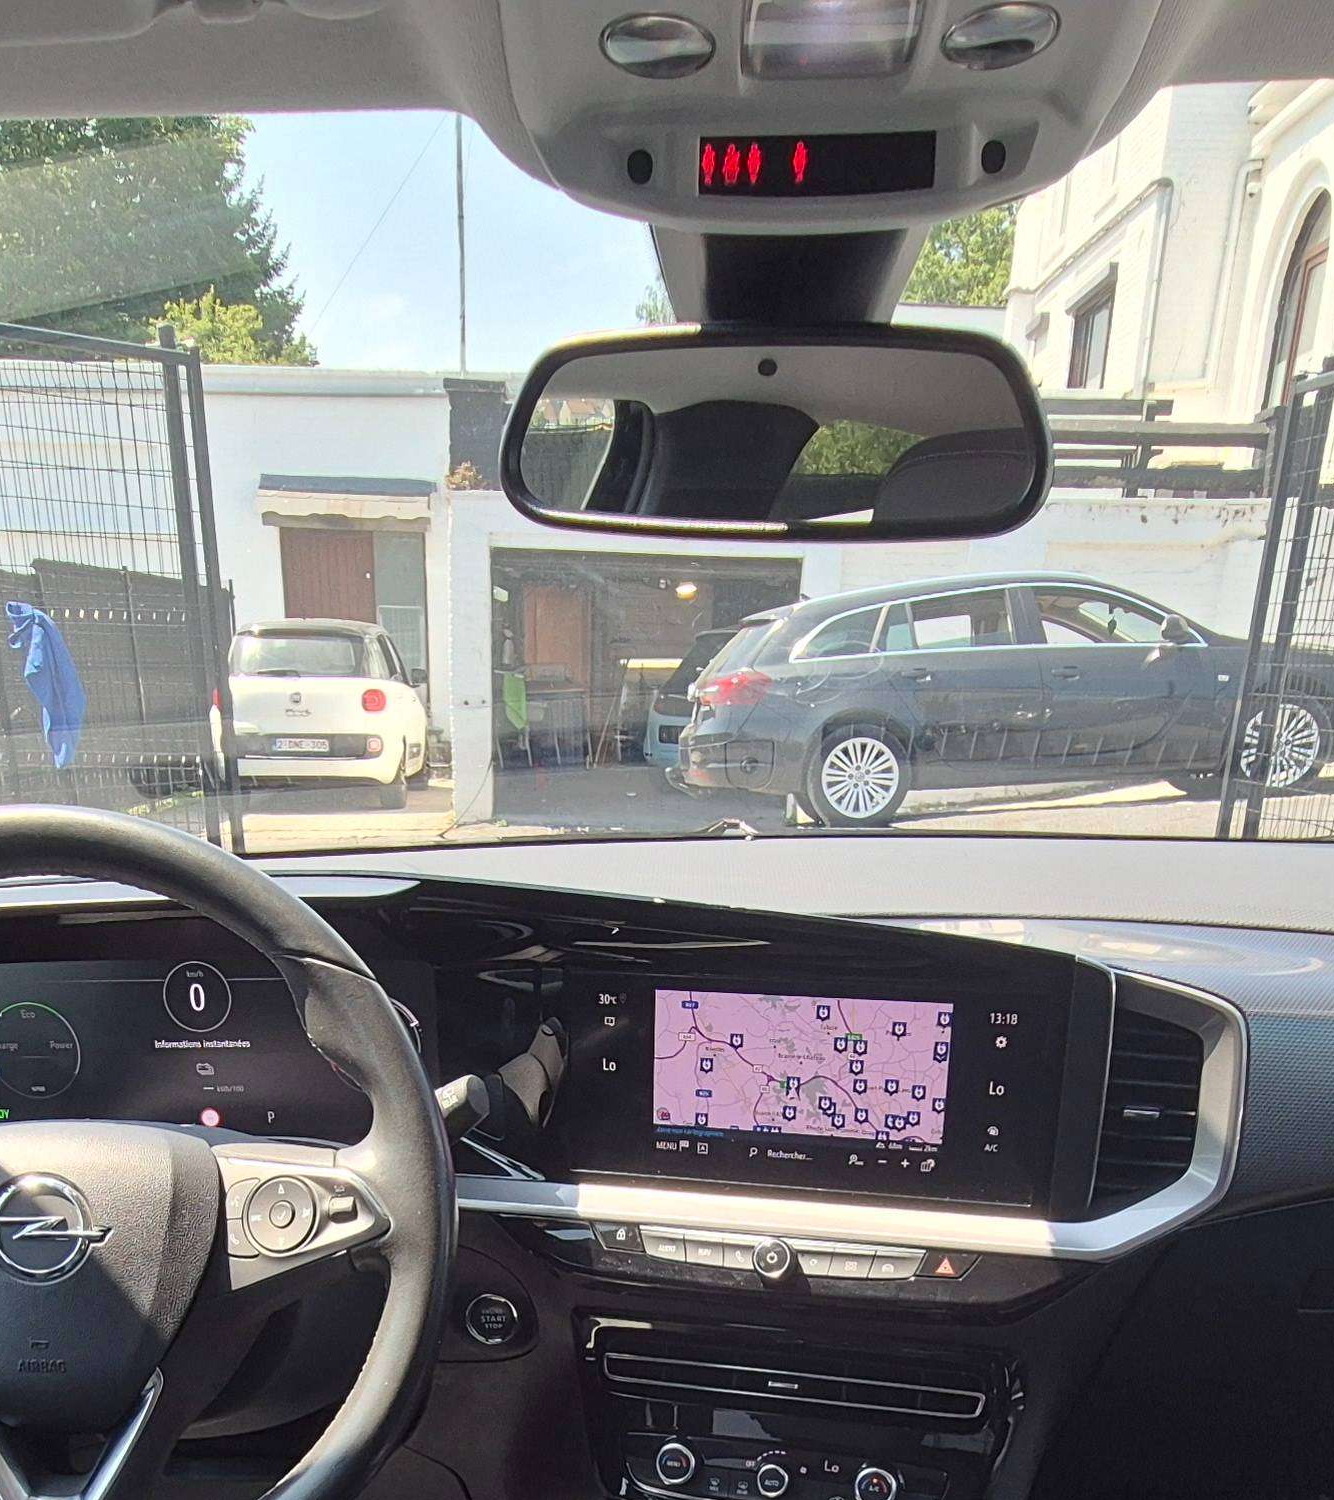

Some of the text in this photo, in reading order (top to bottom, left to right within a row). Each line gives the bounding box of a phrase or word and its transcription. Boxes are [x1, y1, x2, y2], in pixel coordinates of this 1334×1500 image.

[189, 983, 205, 1012] 0
[20, 1009, 36, 1019] Eco
[989, 1012, 1018, 1025] 13:18
[49, 1040, 73, 1049] Power
[154, 1039, 201, 1049] Informations
[602, 1057, 617, 1071] Lo
[988, 1081, 1005, 1096] Lo
[267, 1111, 275, 1123] P
[656, 1140, 677, 1150] MENU
[984, 1143, 999, 1152] A/C
[18, 1359, 67, 1374] AIRBAG
[824, 1459, 840, 1473] Lo
